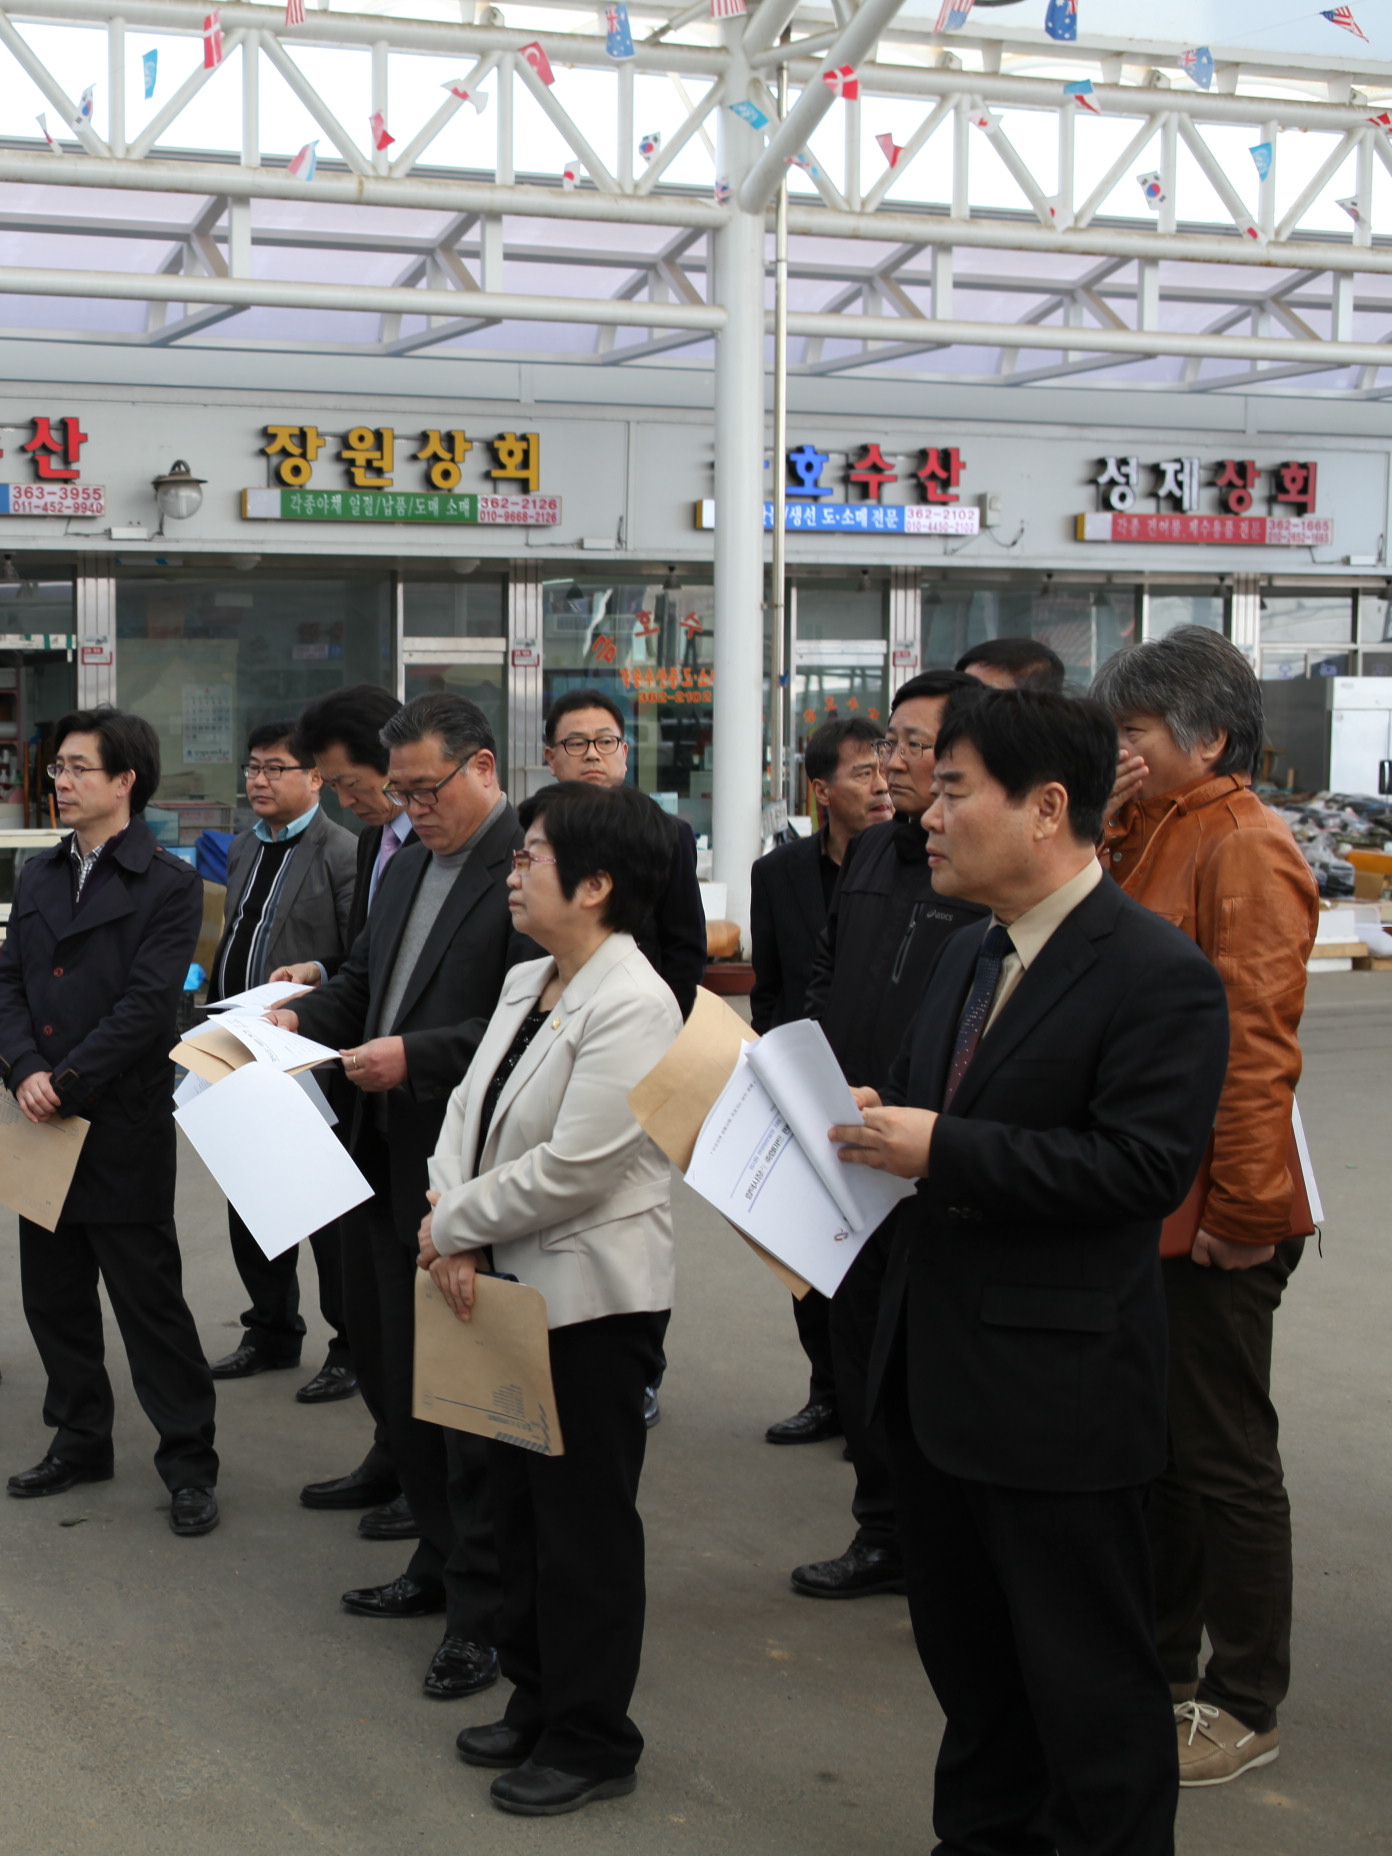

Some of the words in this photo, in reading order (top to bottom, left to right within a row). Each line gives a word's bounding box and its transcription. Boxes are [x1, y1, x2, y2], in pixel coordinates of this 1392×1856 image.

[262, 425, 540, 492] 장원상회
[764, 443, 966, 502] 호수산
[12, 485, 102, 501] 363-3955
[1096, 456, 1318, 514] 성제상회
[12, 500, 103, 514] 011-452-9940
[289, 493, 342, 516] 각종야채
[446, 497, 470, 519] 소매
[480, 497, 558, 510] 362-2126
[906, 508, 975, 520] 362-2102
[872, 508, 899, 529] 전문
